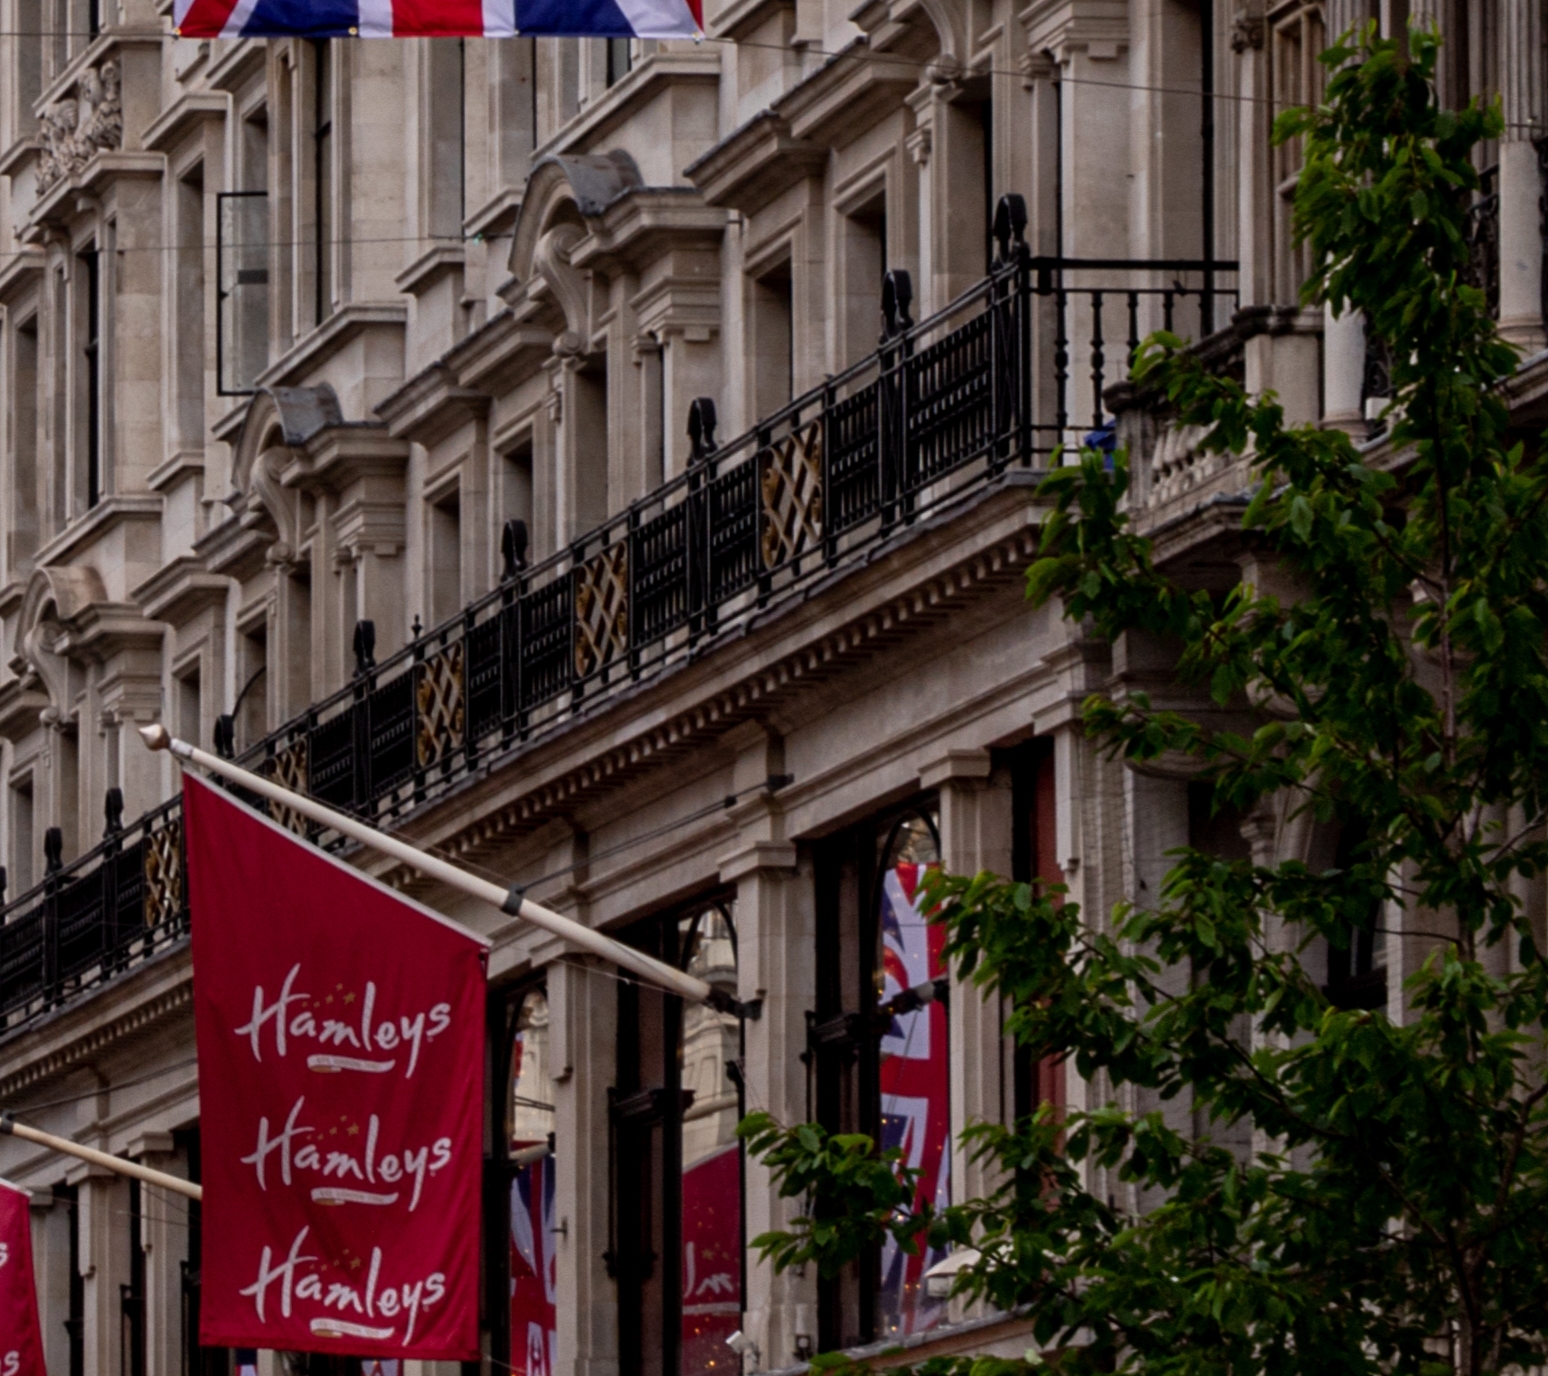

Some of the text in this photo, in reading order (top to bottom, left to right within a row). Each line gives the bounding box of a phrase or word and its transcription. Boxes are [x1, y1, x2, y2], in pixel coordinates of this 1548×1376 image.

[234, 962, 451, 1079] Hamleys
[240, 1095, 452, 1212] Hamleys
[239, 1225, 446, 1347] Hamleys
